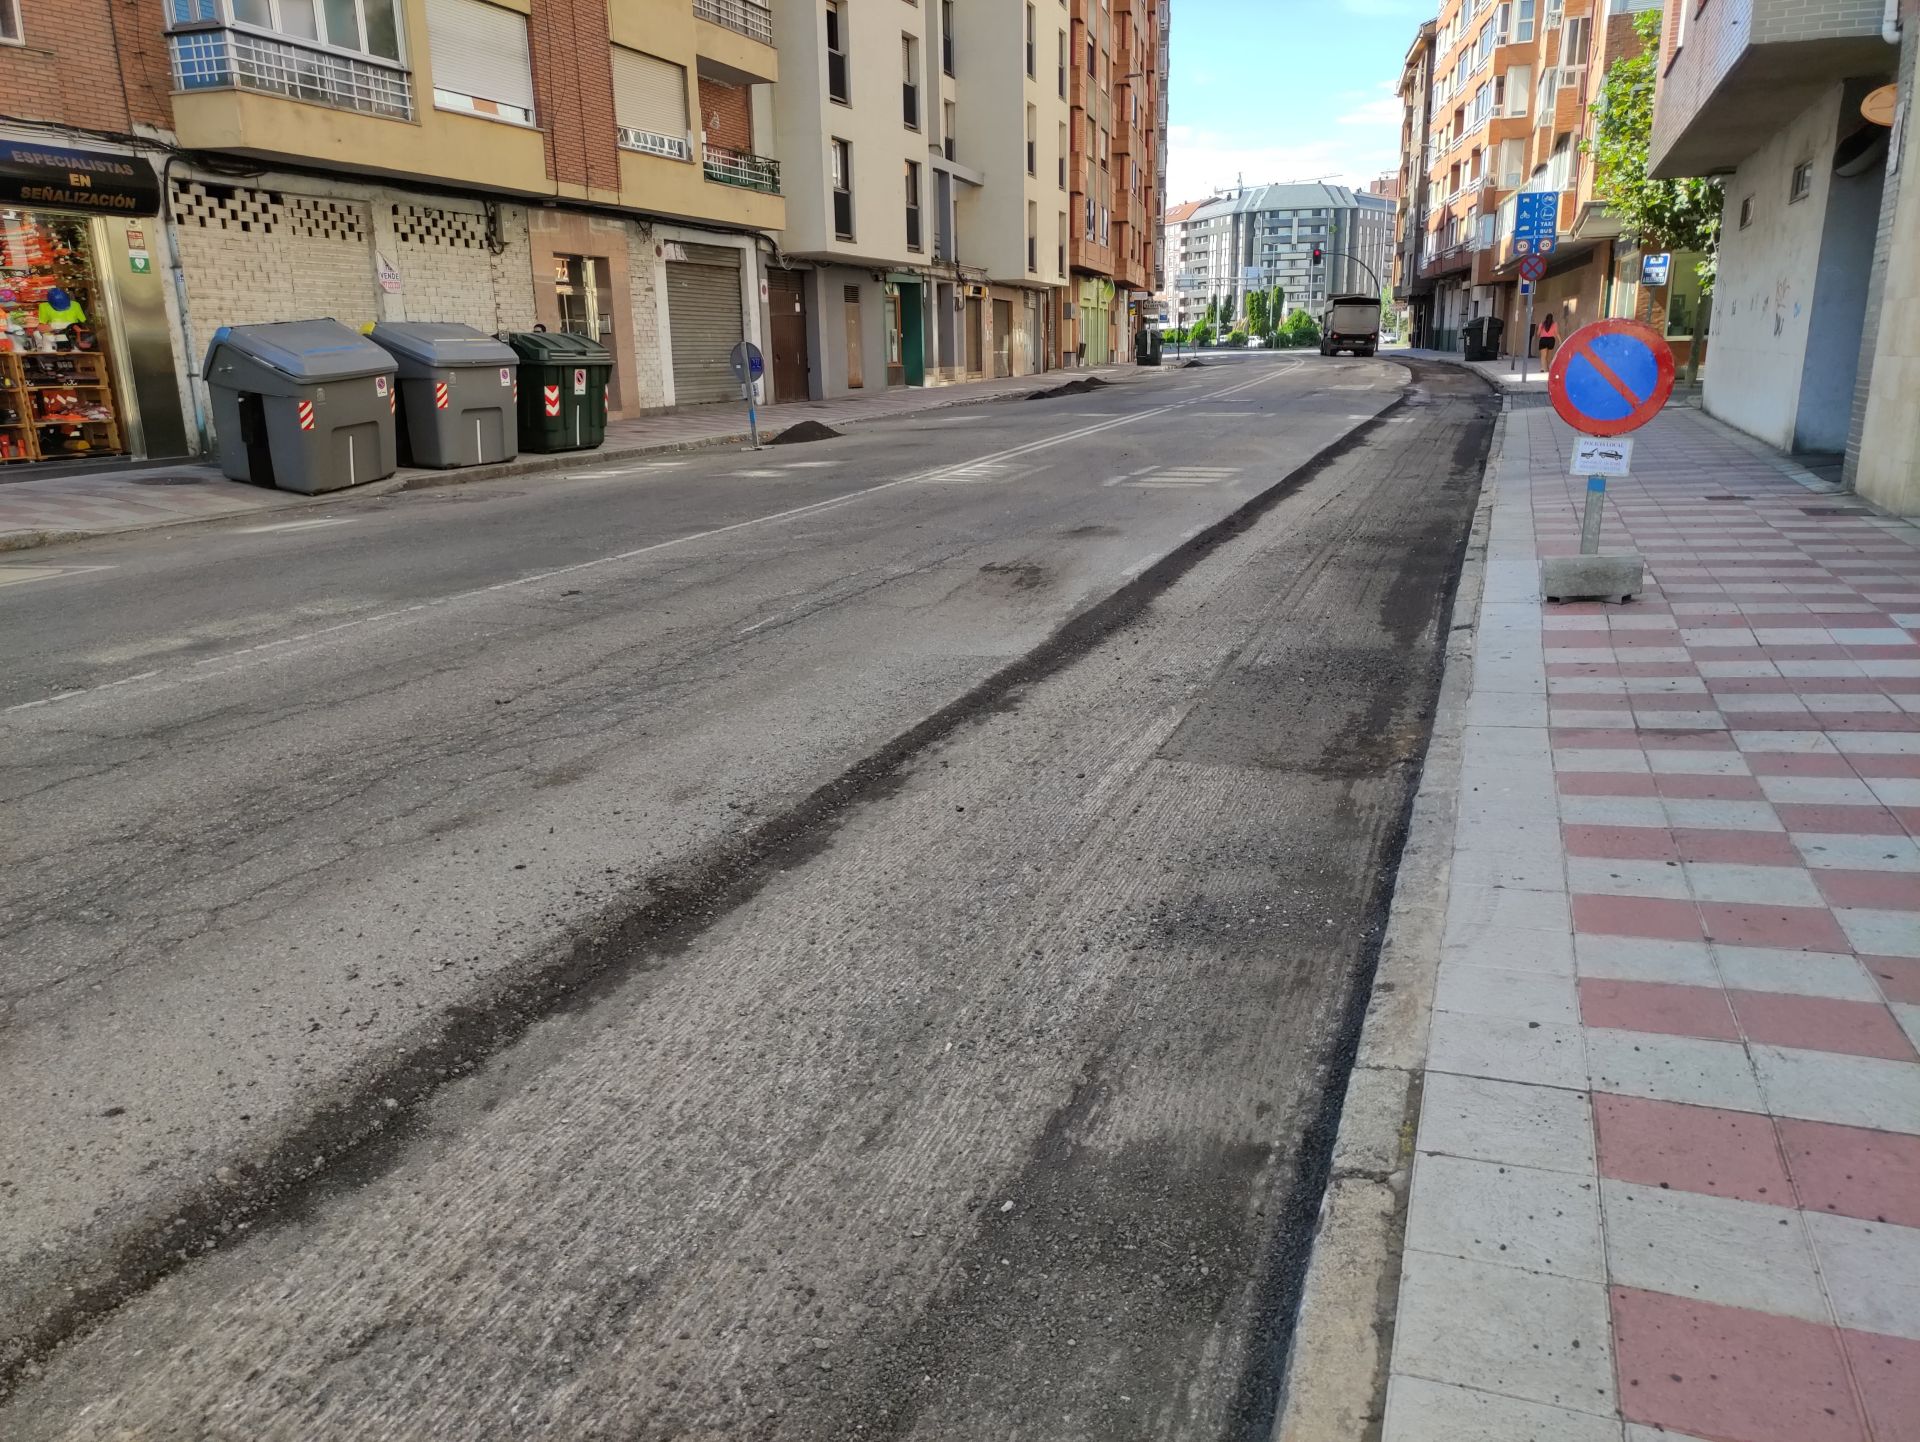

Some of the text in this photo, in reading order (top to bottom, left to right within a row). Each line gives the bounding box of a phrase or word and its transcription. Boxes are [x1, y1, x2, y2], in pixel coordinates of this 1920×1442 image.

[11, 150, 134, 176] ESPECIALISTAS
[69, 173, 91, 187] EN
[20, 186, 136, 209] SEÑALIZACIÓN
[380, 272, 400, 280] VENDE
[555, 267, 569, 280] 72
